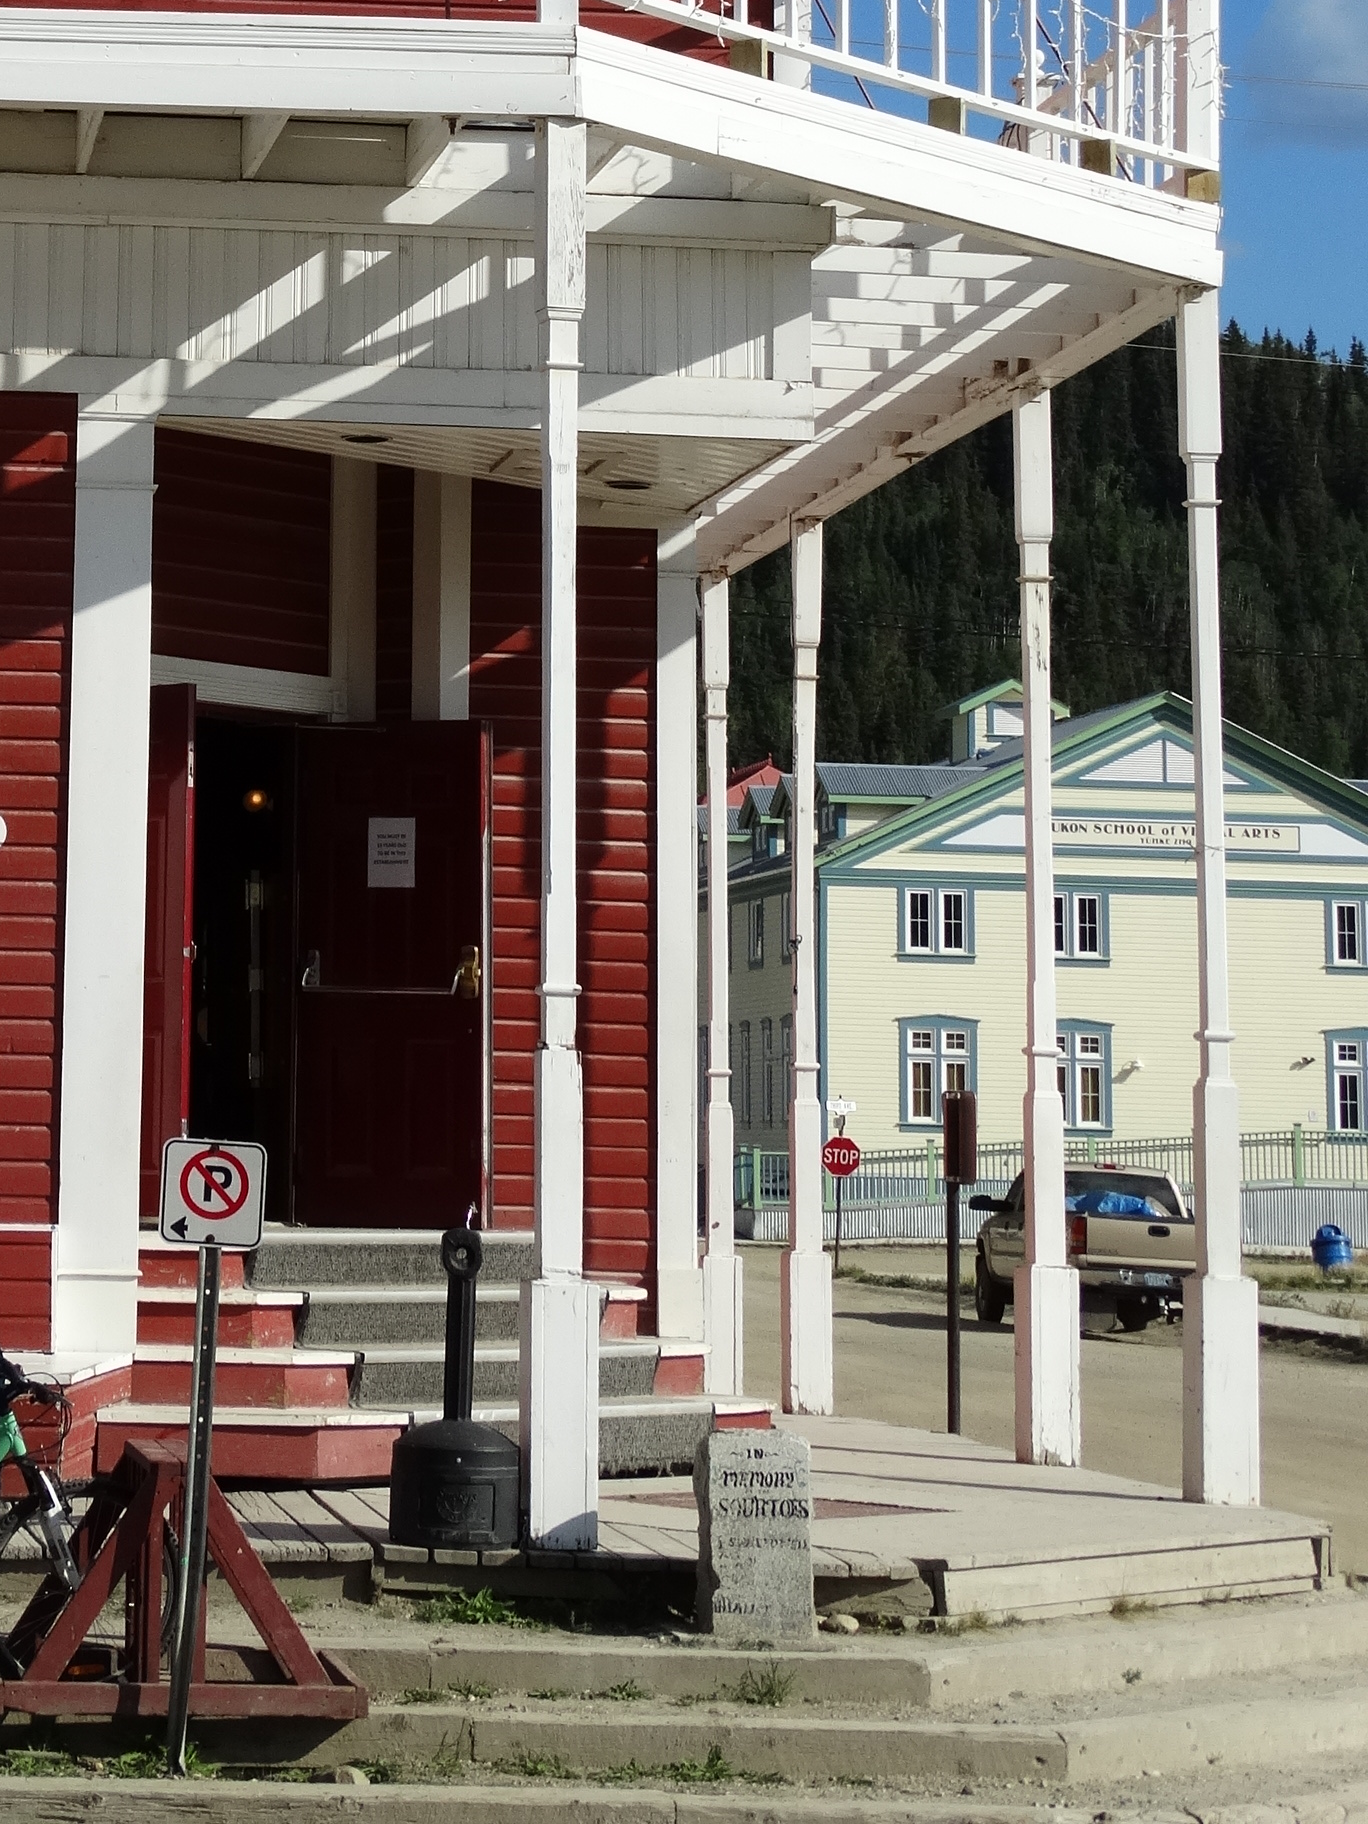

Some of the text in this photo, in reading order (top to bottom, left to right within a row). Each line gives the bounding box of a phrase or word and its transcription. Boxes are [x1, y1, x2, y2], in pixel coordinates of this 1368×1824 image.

[1051, 822, 1088, 834] UKON
[1093, 823, 1156, 836] SCHOOL
[1161, 825, 1175, 836] of
[1241, 827, 1281, 839] ARTS
[823, 1147, 859, 1166] STOP
[746, 1448, 764, 1460] IN
[722, 1470, 795, 1489] MEMORY
[718, 1495, 810, 1519] SOURTOES
